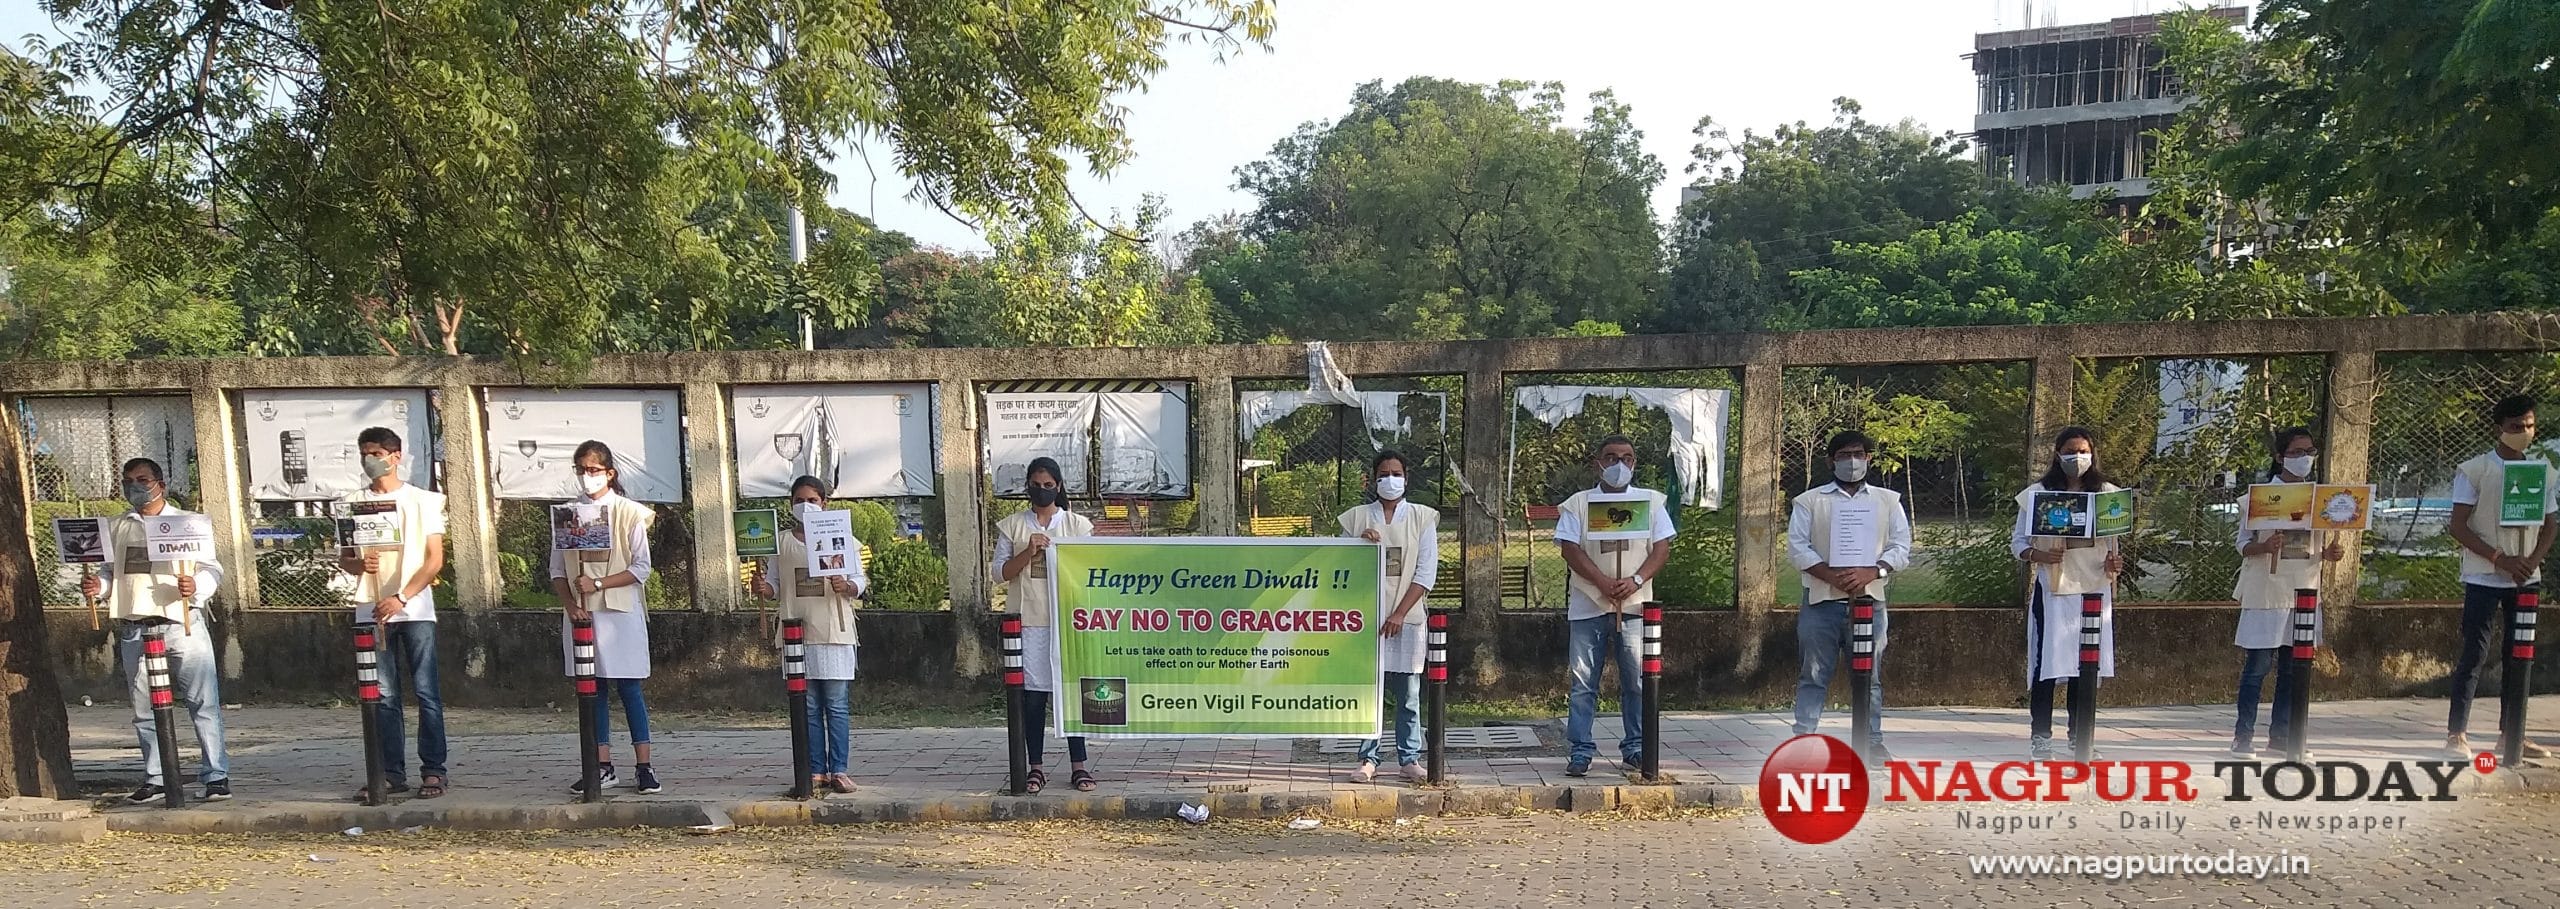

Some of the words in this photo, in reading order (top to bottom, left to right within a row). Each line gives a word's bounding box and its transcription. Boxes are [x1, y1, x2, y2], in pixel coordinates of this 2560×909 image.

[1015, 400, 1025, 410] पर
[1027, 400, 1036, 410] हर
[1038, 400, 1056, 410] कदम
[1086, 568, 1164, 595] Happy
[1171, 568, 1237, 589] Green
[1242, 567, 1319, 590] Diwali
[1332, 569, 1351, 590] !!
[1073, 609, 1123, 631] SAY
[1131, 609, 1169, 631] NO
[1177, 609, 1212, 631] TO
[1221, 609, 1363, 631] CRACKERS
[1105, 645, 1123, 656] Let
[1126, 647, 1139, 656] us
[1142, 645, 1166, 656] take
[1169, 645, 1193, 656] oath
[1196, 646, 1207, 656] to
[1210, 646, 1248, 656] reduce
[1251, 646, 1269, 656] the
[1272, 646, 1330, 659] poisonous
[1146, 658, 1177, 669] effect
[1180, 660, 1194, 669] on
[1197, 660, 1215, 669] our
[1219, 658, 1257, 669] Mother
[1260, 658, 1290, 669] Earth
[1141, 694, 1198, 710] Green
[1203, 694, 1245, 714] Vigil
[1251, 694, 1358, 710] Foundation
